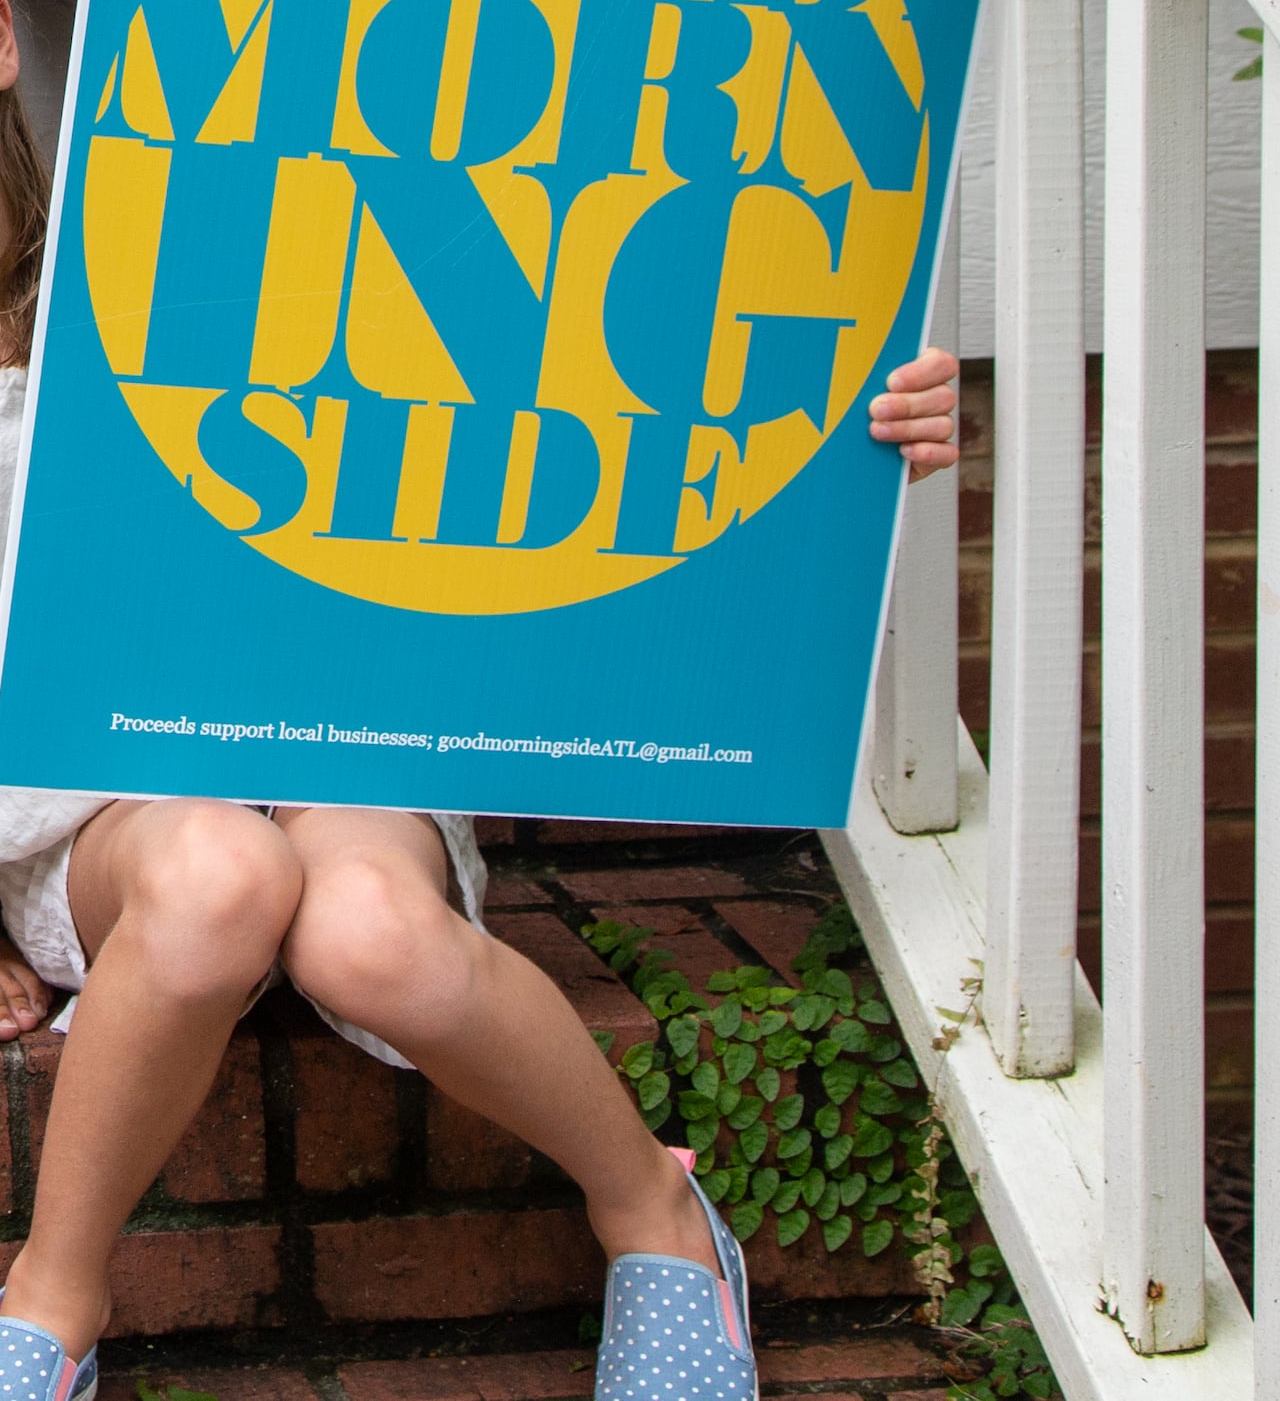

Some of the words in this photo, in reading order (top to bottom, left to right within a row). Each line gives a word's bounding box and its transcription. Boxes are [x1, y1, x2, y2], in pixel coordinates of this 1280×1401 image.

[114, 141, 857, 436] ING
[184, 389, 752, 558] SIDE
[109, 712, 196, 735] Proceeds
[199, 722, 276, 742] support
[278, 721, 324, 742] local
[327, 723, 434, 751] businesses;
[436, 731, 753, 764] goodmorningsideATL@gmail.com
